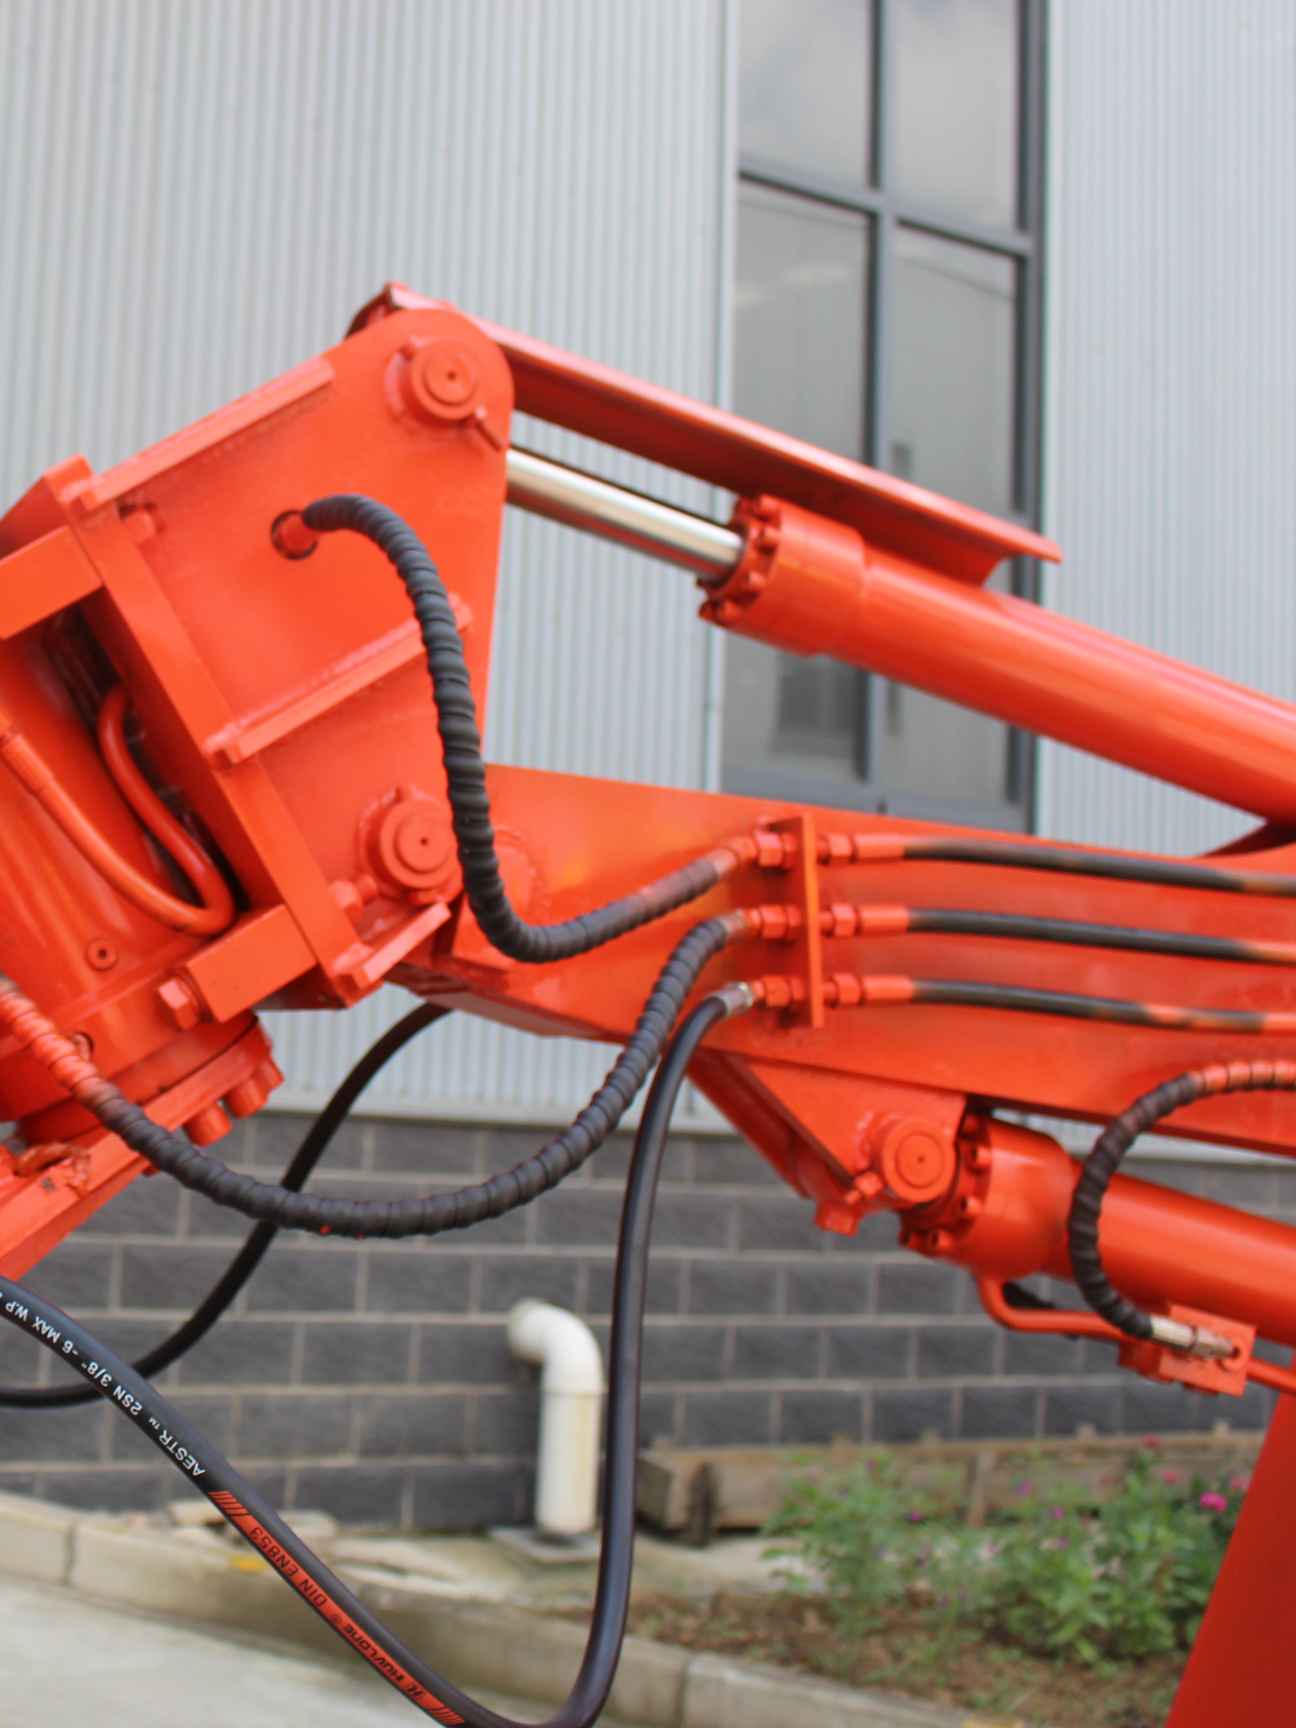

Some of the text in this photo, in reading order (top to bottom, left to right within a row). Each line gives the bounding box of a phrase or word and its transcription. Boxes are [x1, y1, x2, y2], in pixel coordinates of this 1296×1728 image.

[32, 1316, 61, 1343] MAX
[112, 1385, 143, 1415] 2SN
[159, 1430, 206, 1476] AESTR
